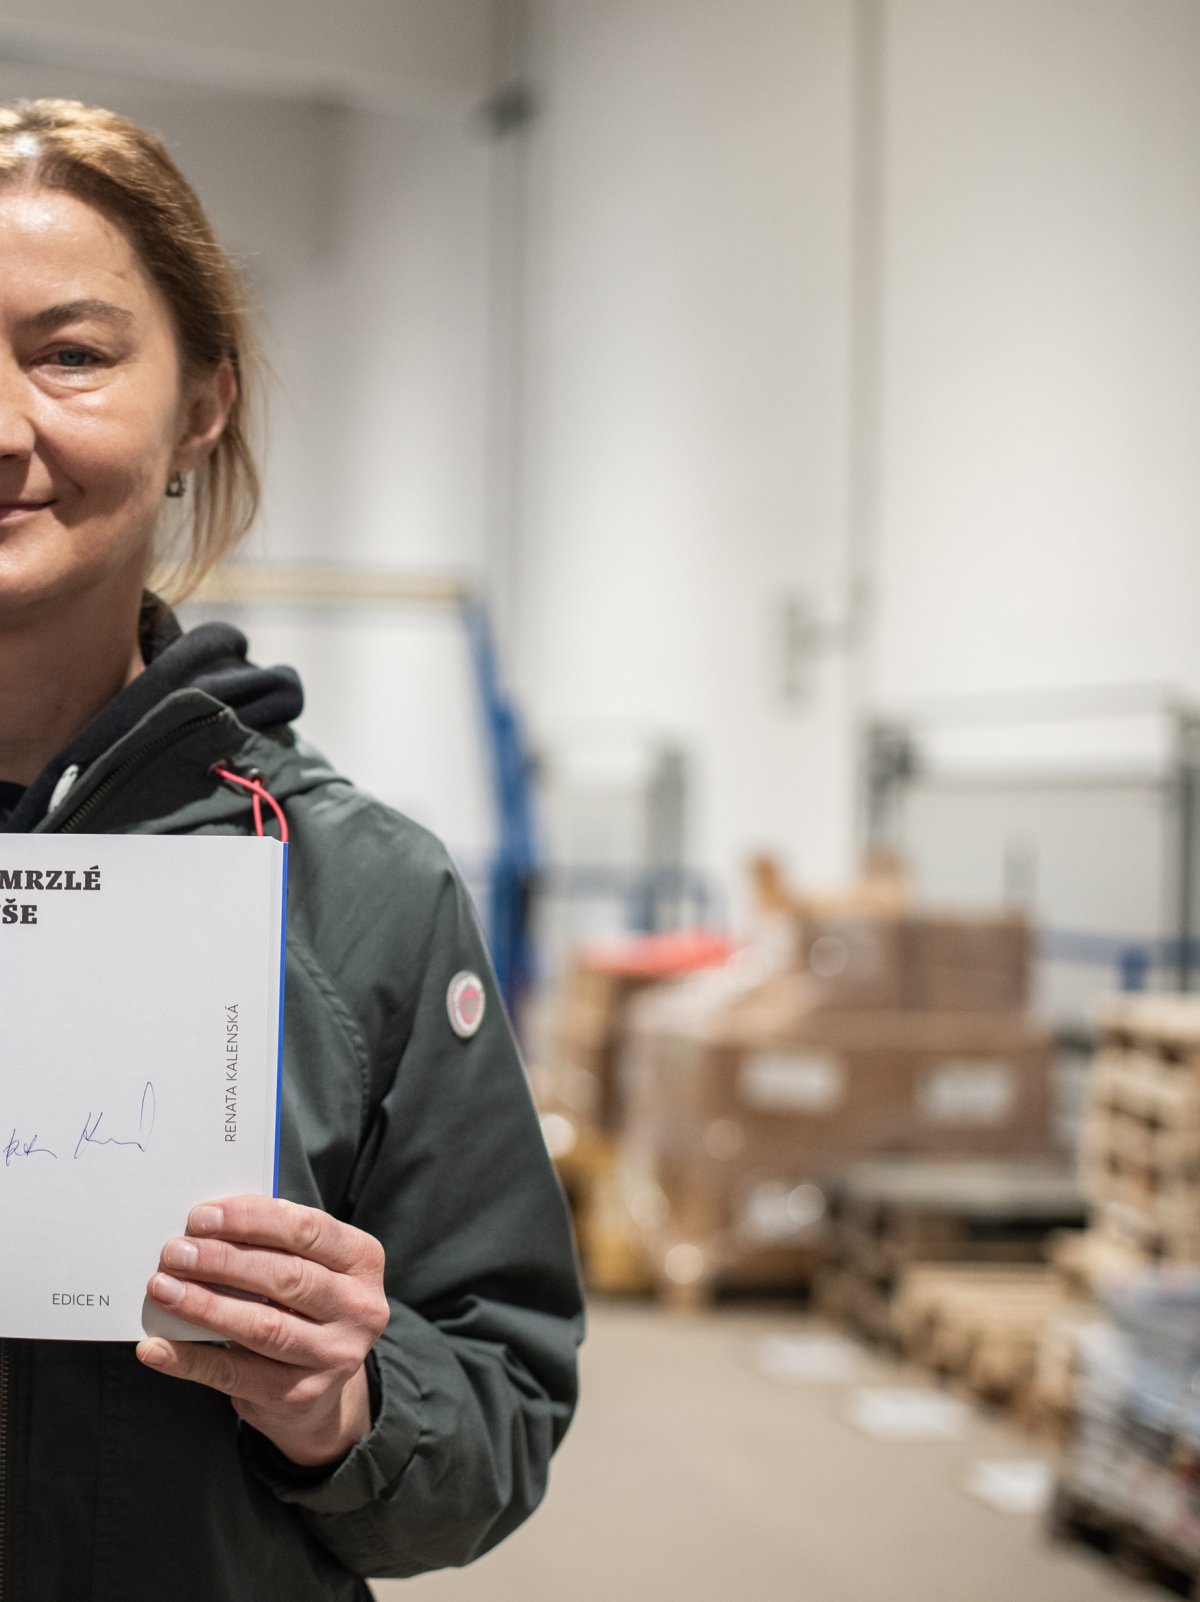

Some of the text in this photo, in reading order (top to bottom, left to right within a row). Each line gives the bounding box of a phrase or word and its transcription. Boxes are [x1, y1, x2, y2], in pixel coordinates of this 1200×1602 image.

[224, 1003, 239, 1142] RENATA KALENSKÁ
[52, 1293, 110, 1307] EDICE N
